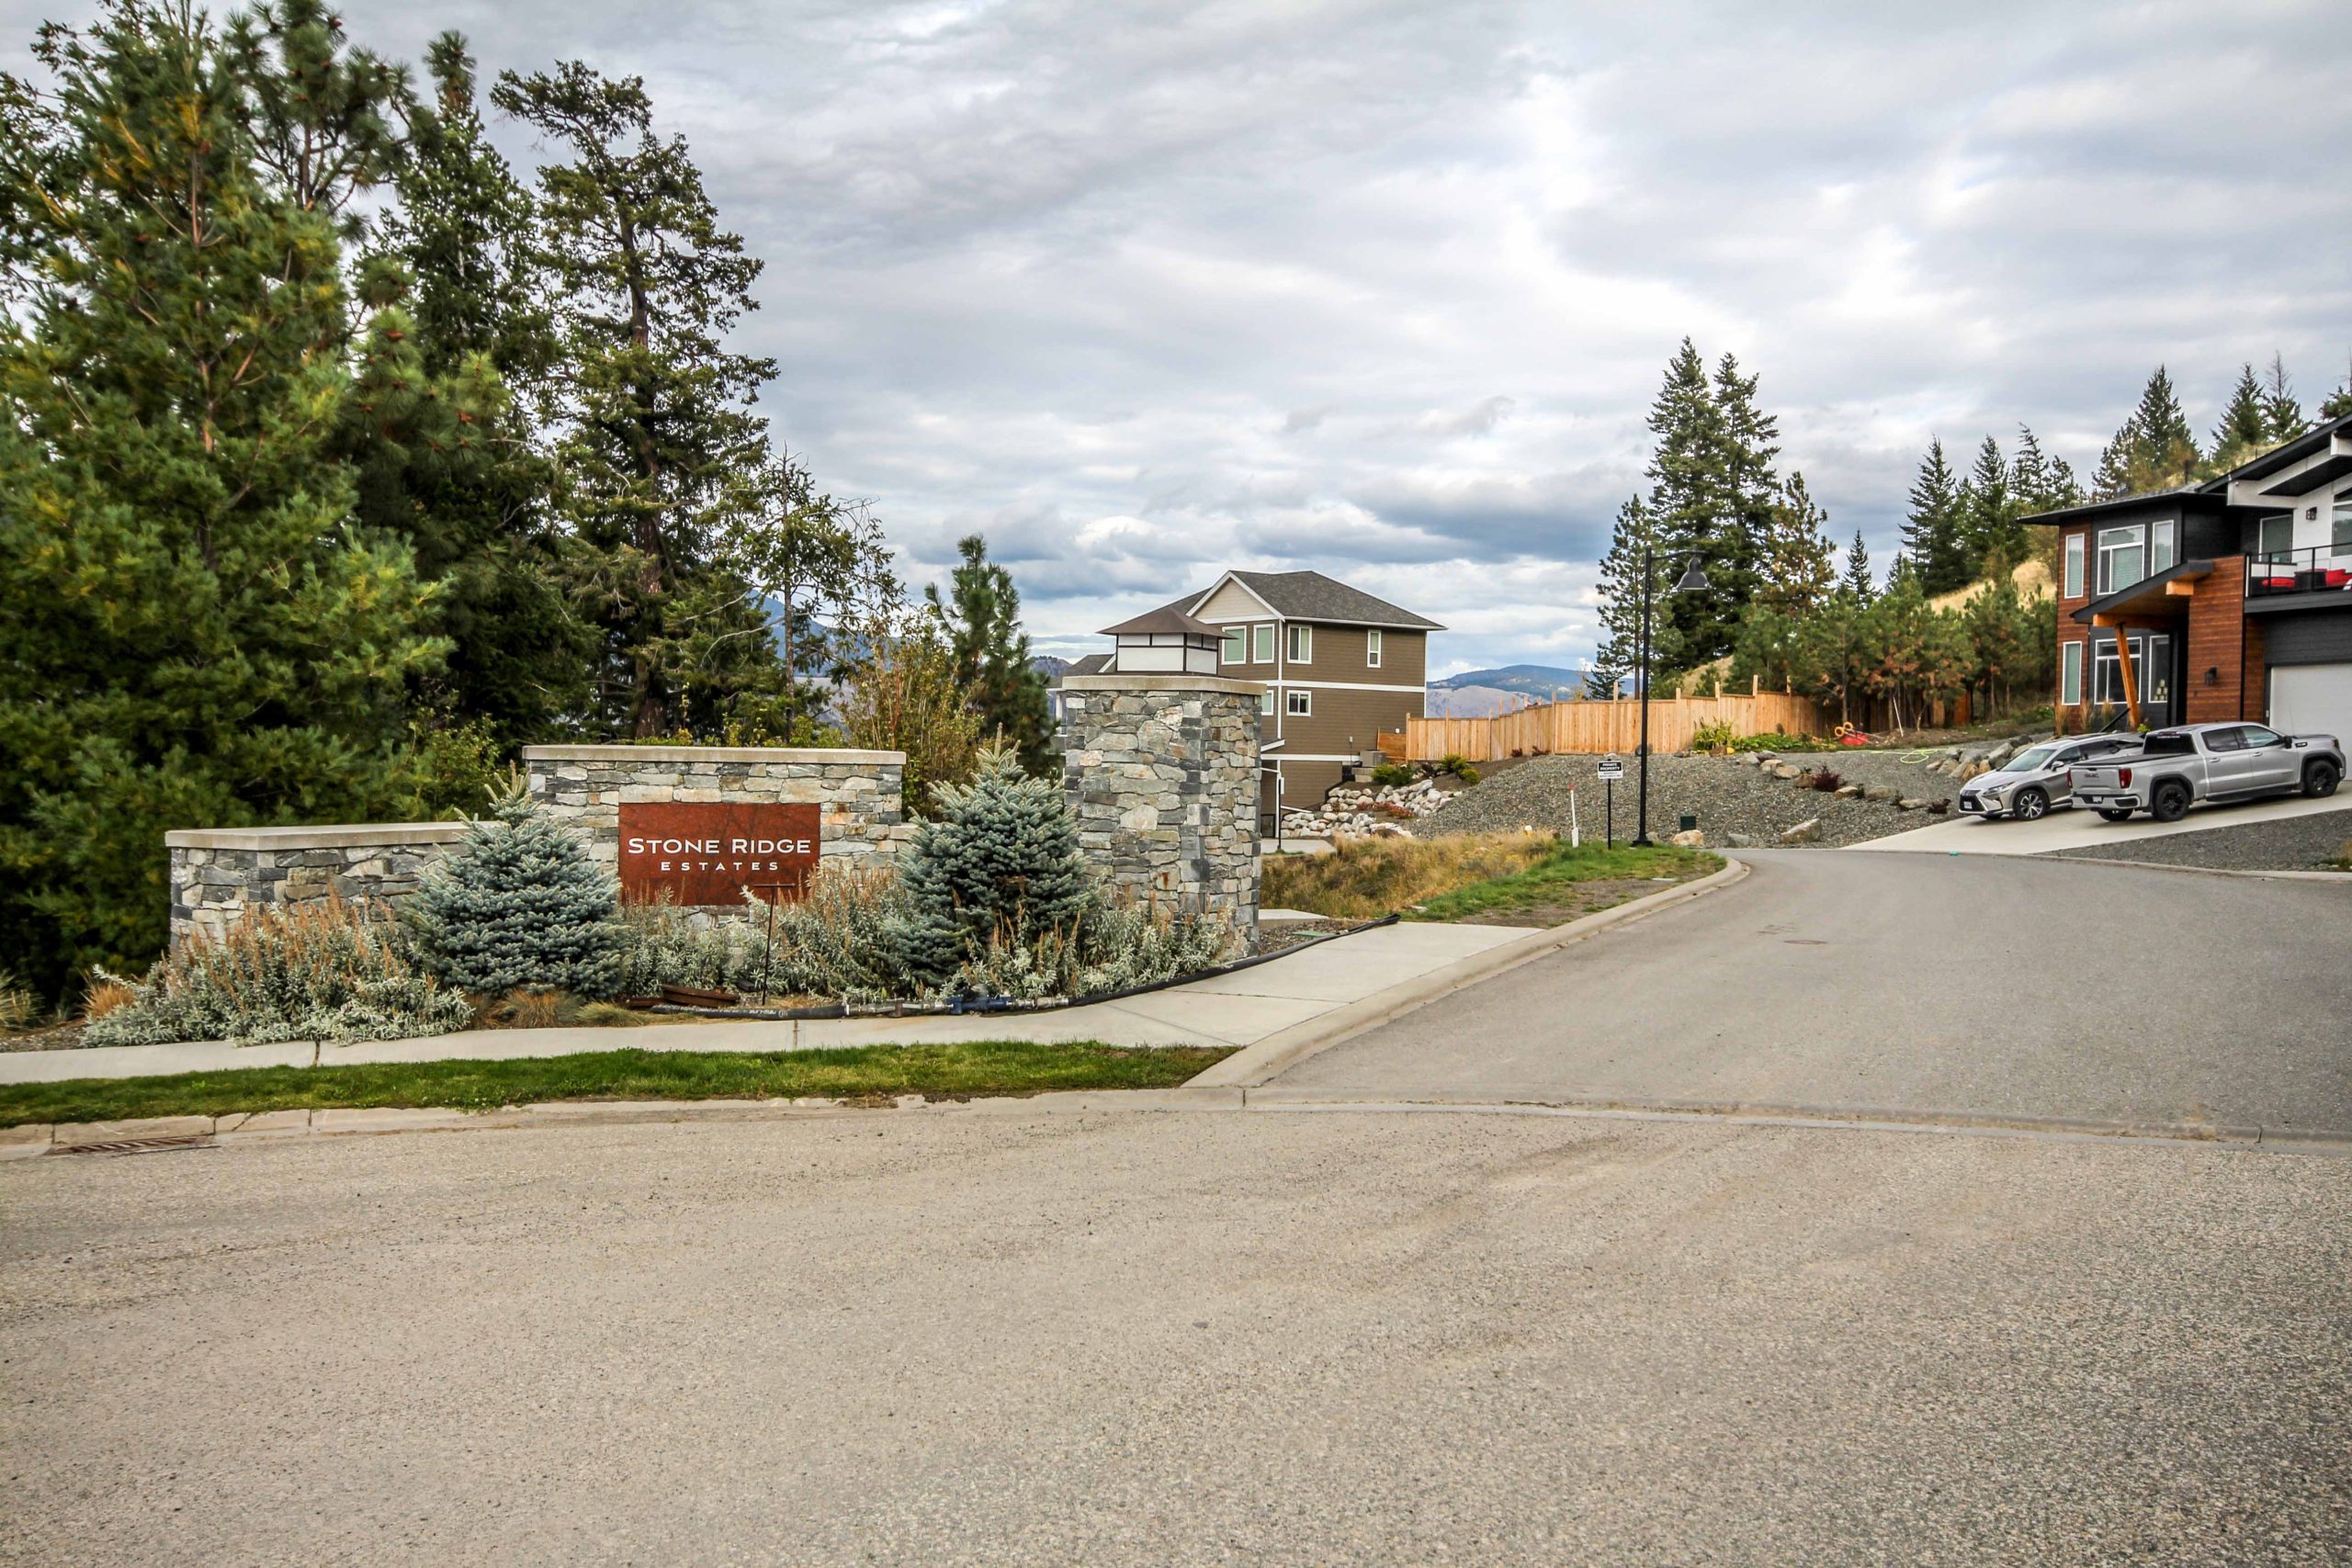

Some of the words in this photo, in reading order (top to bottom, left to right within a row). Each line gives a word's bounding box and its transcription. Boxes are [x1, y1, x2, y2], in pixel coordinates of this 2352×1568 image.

[628, 838, 720, 854] STONE
[731, 838, 811, 854] RIDGE
[661, 861, 778, 871] ESTATES
